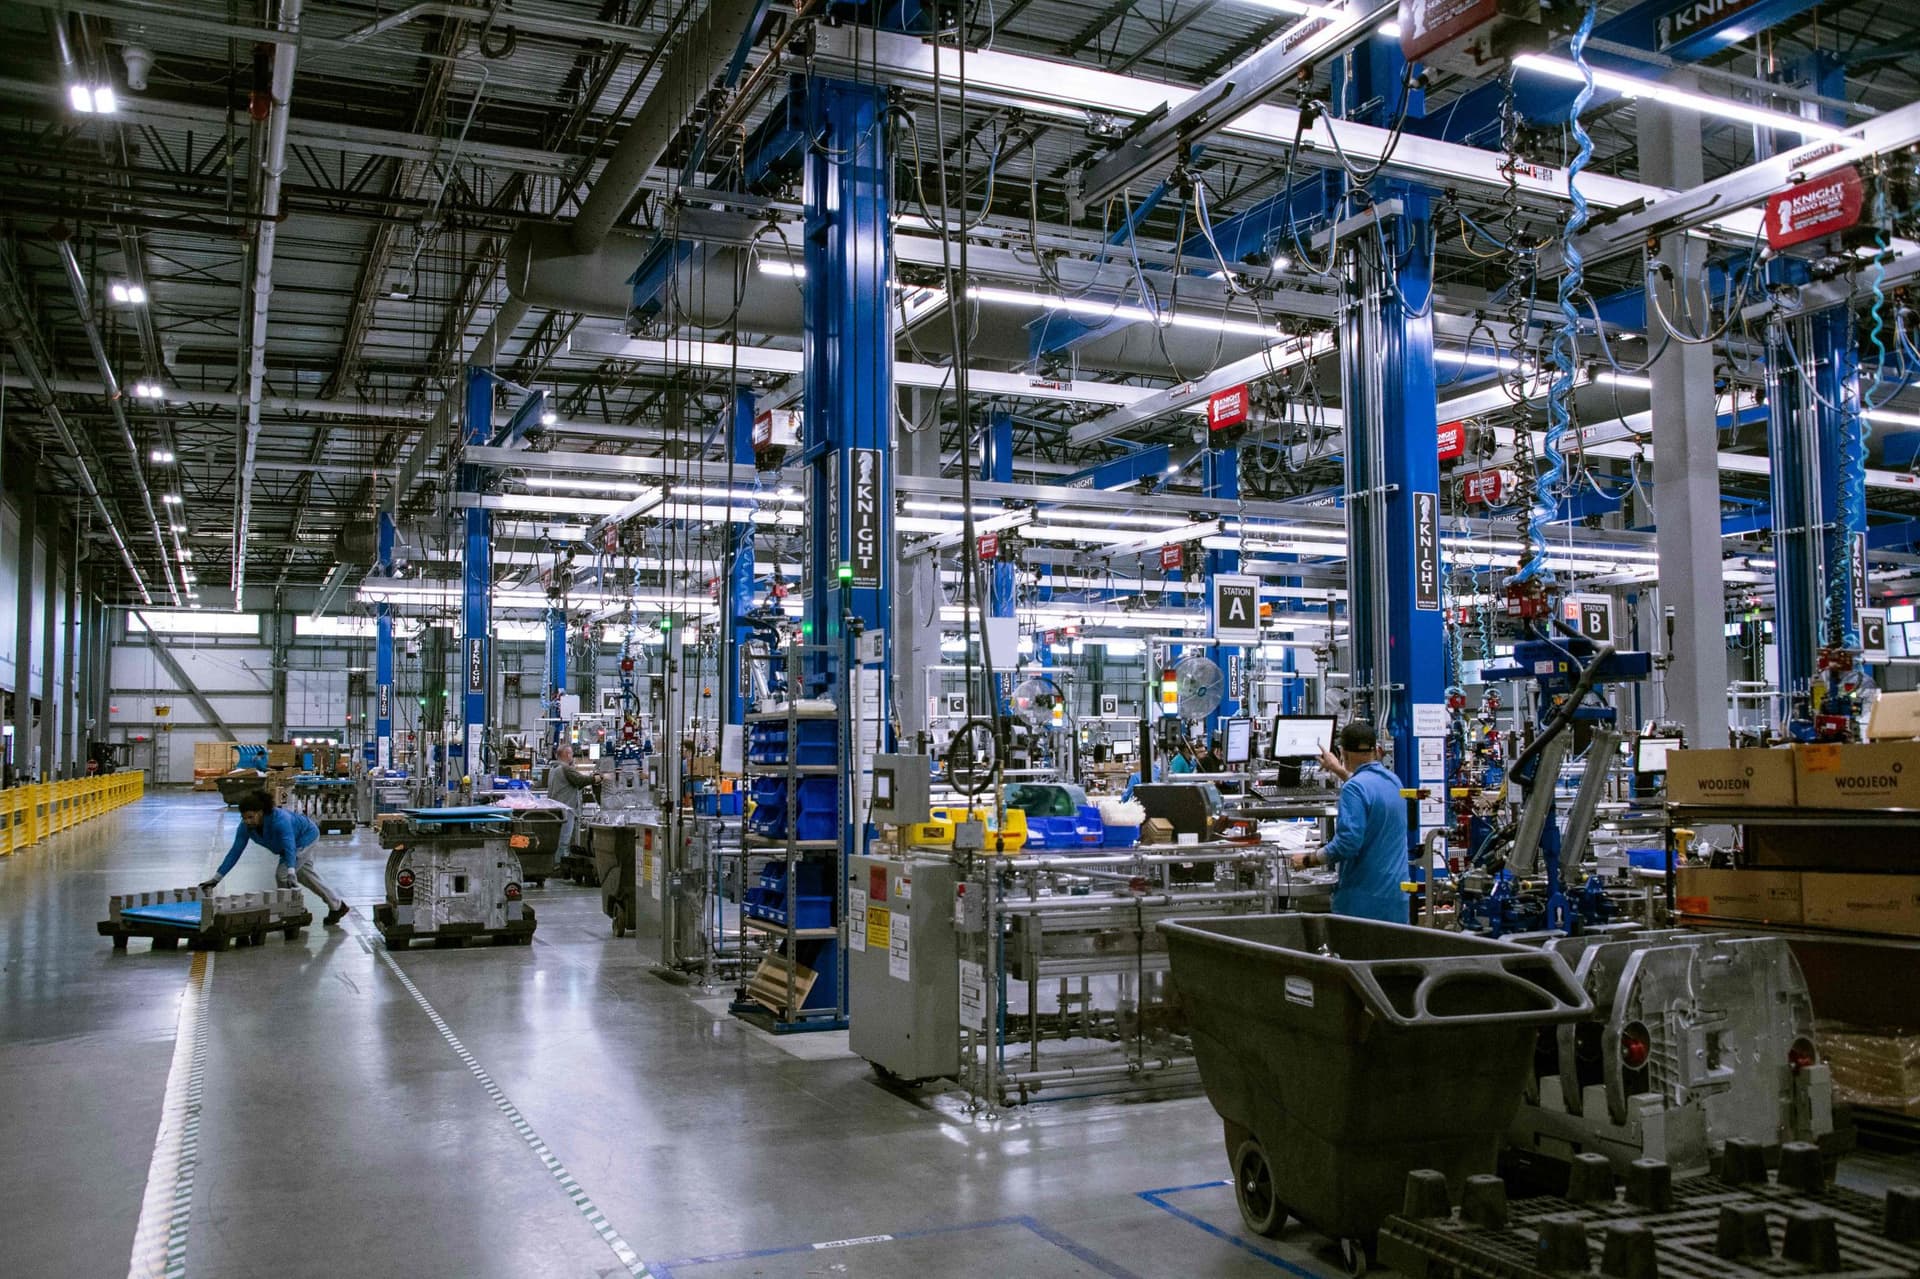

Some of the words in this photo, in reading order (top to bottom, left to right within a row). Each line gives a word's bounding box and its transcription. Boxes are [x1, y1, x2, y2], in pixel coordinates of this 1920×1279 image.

[1792, 182, 1845, 208] KNIGHT
[829, 486, 837, 571] KNIGHT
[857, 485, 873, 569] KNIGHT
[1420, 524, 1432, 594] KNIGHT
[1223, 587, 1251, 596] STATION
[1852, 558, 1863, 607] KNIGH
[1228, 597, 1246, 620] A
[1589, 612, 1602, 633] B
[1868, 625, 1880, 644] C
[472, 653, 480, 687] KNIGHT
[608, 696, 617, 706] A
[953, 700, 961, 710] C
[1105, 701, 1113, 711] D
[1698, 779, 1750, 790] WOOJEON
[1835, 776, 1898, 788] WOOJEON
